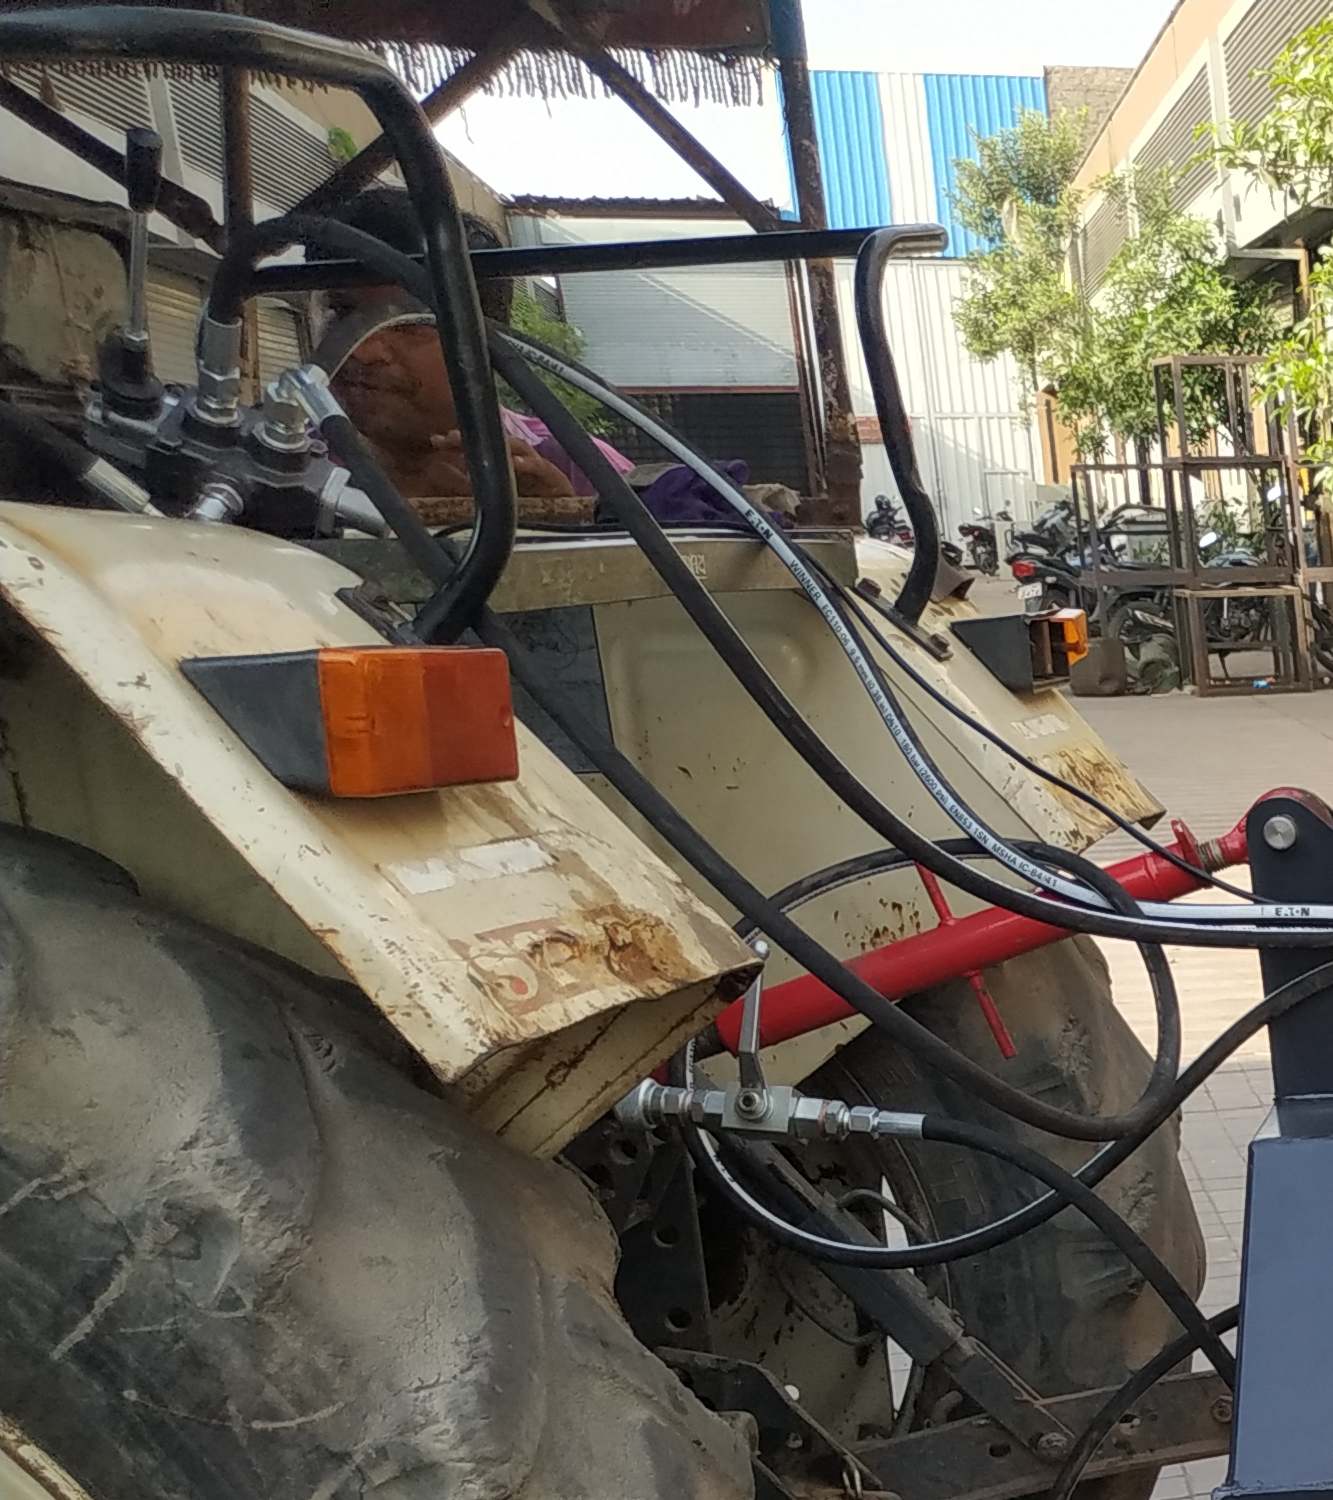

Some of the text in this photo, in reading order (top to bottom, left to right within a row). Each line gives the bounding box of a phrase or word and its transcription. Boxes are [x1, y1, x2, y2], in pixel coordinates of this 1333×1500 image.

[790, 559, 822, 601] WINNER
[821, 603, 850, 647] EC110-06
[885, 713, 901, 737] DN10
[901, 738, 912, 755] 180
[910, 752, 921, 769] bar
[949, 804, 974, 830] EN853
[973, 828, 990, 845] 1SN
[991, 844, 1018, 866] MSHA
[1018, 862, 1058, 888] IC-84/41
